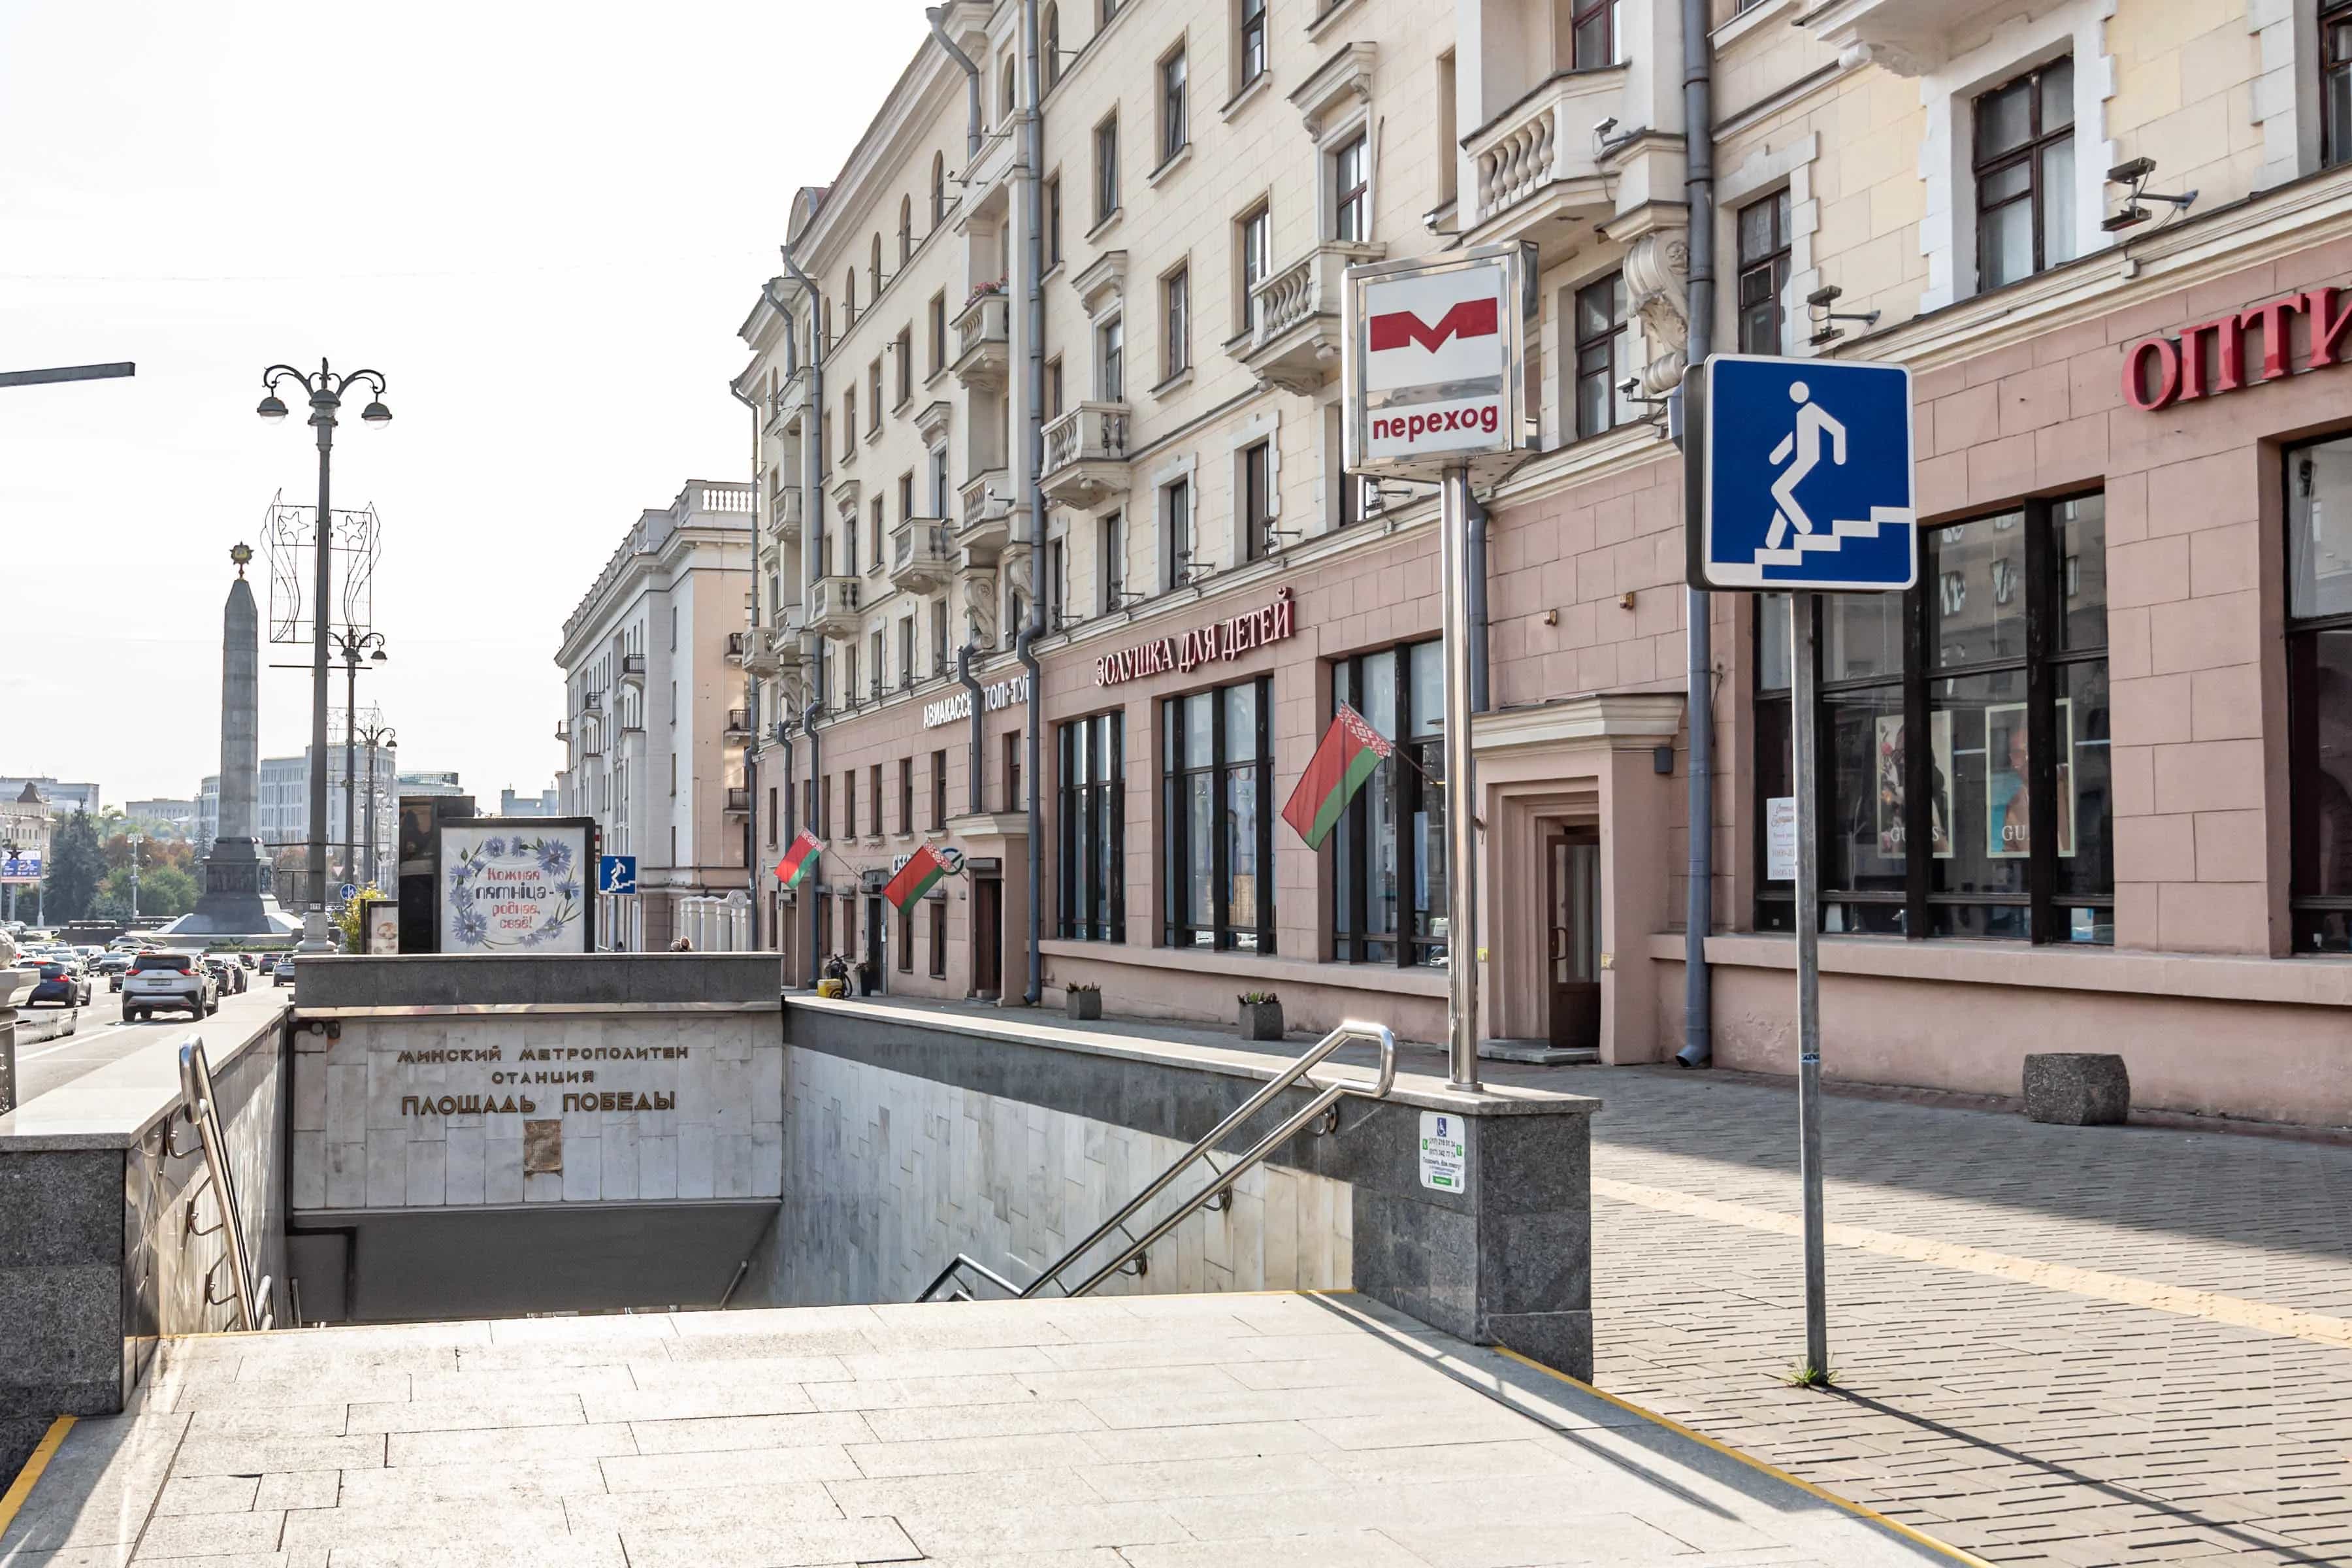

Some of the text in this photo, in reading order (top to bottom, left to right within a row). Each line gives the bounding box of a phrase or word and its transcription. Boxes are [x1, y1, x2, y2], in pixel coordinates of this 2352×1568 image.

[1373, 405, 1497, 443] переход
[1096, 587, 1295, 687] ЗОЛУШКА ДЛЯ ДЕТЕЙ
[487, 868, 540, 881] Кожная
[397, 1045, 689, 1062] МИНСКИЙ МЕТРОПОЛИТЕН
[402, 1090, 676, 1115] ПЛОЩАДЬ ПОБЕДЫ
